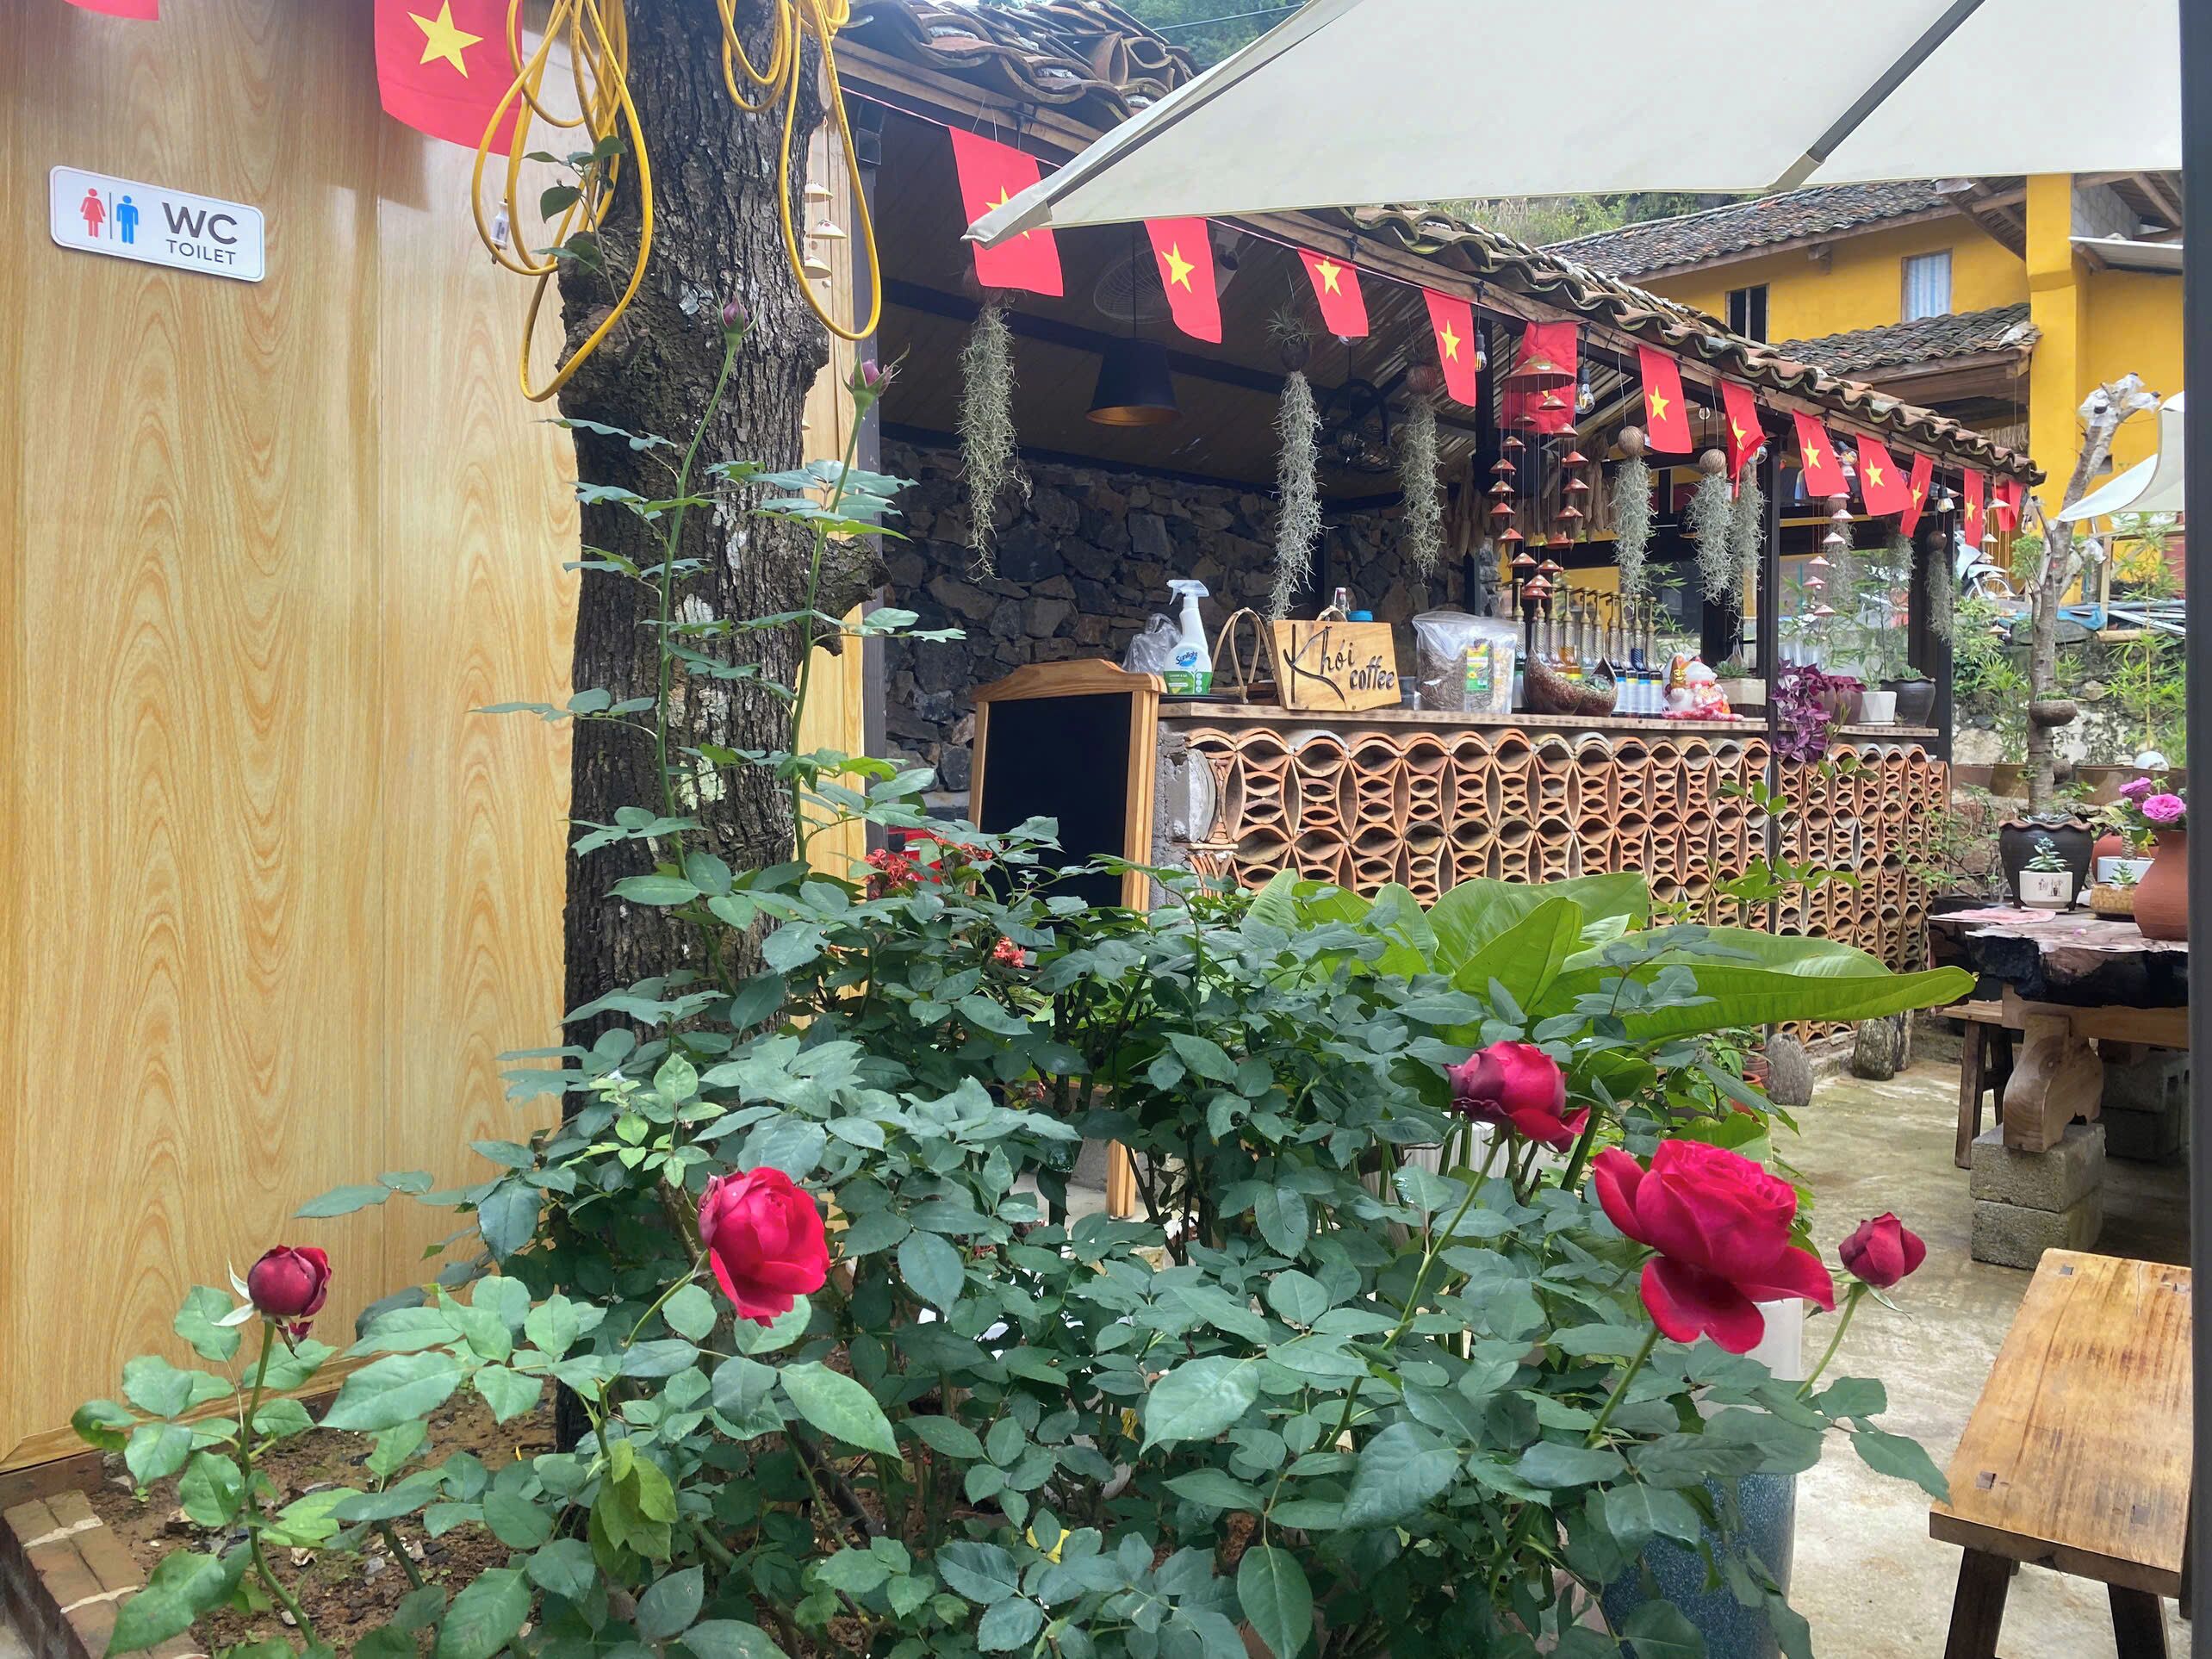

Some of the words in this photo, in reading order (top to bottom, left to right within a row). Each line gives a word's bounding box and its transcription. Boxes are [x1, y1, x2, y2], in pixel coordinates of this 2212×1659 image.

[162, 202, 238, 245] WC
[165, 239, 237, 265] TOILET
[1175, 650, 1198, 665] Sunlight
[1349, 655, 1395, 690] coffee
